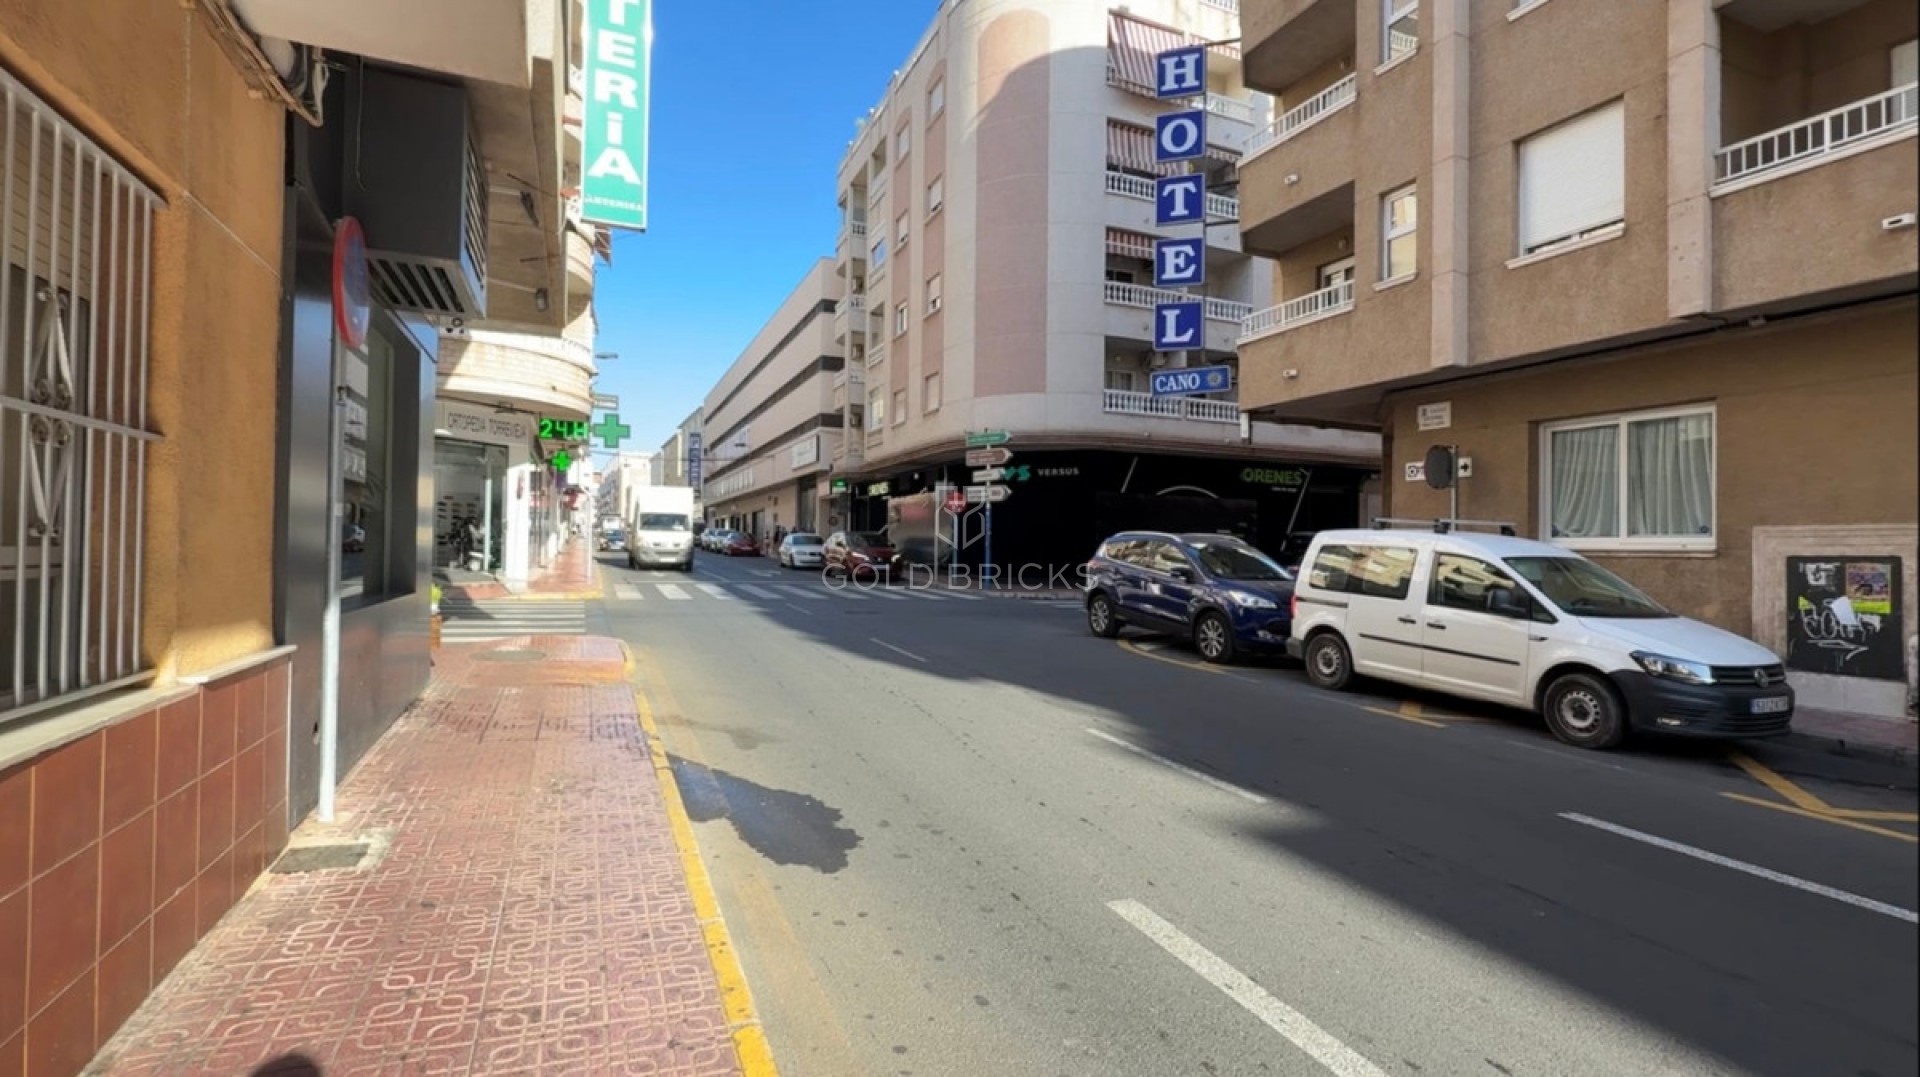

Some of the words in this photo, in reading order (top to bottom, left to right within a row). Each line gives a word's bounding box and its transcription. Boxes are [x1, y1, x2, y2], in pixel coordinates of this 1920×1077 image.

[1159, 52, 1201, 345] HOTEL
[1155, 372, 1200, 393] CANO
[1037, 466, 1080, 477] VERSUS
[1242, 468, 1302, 485] ORENES
